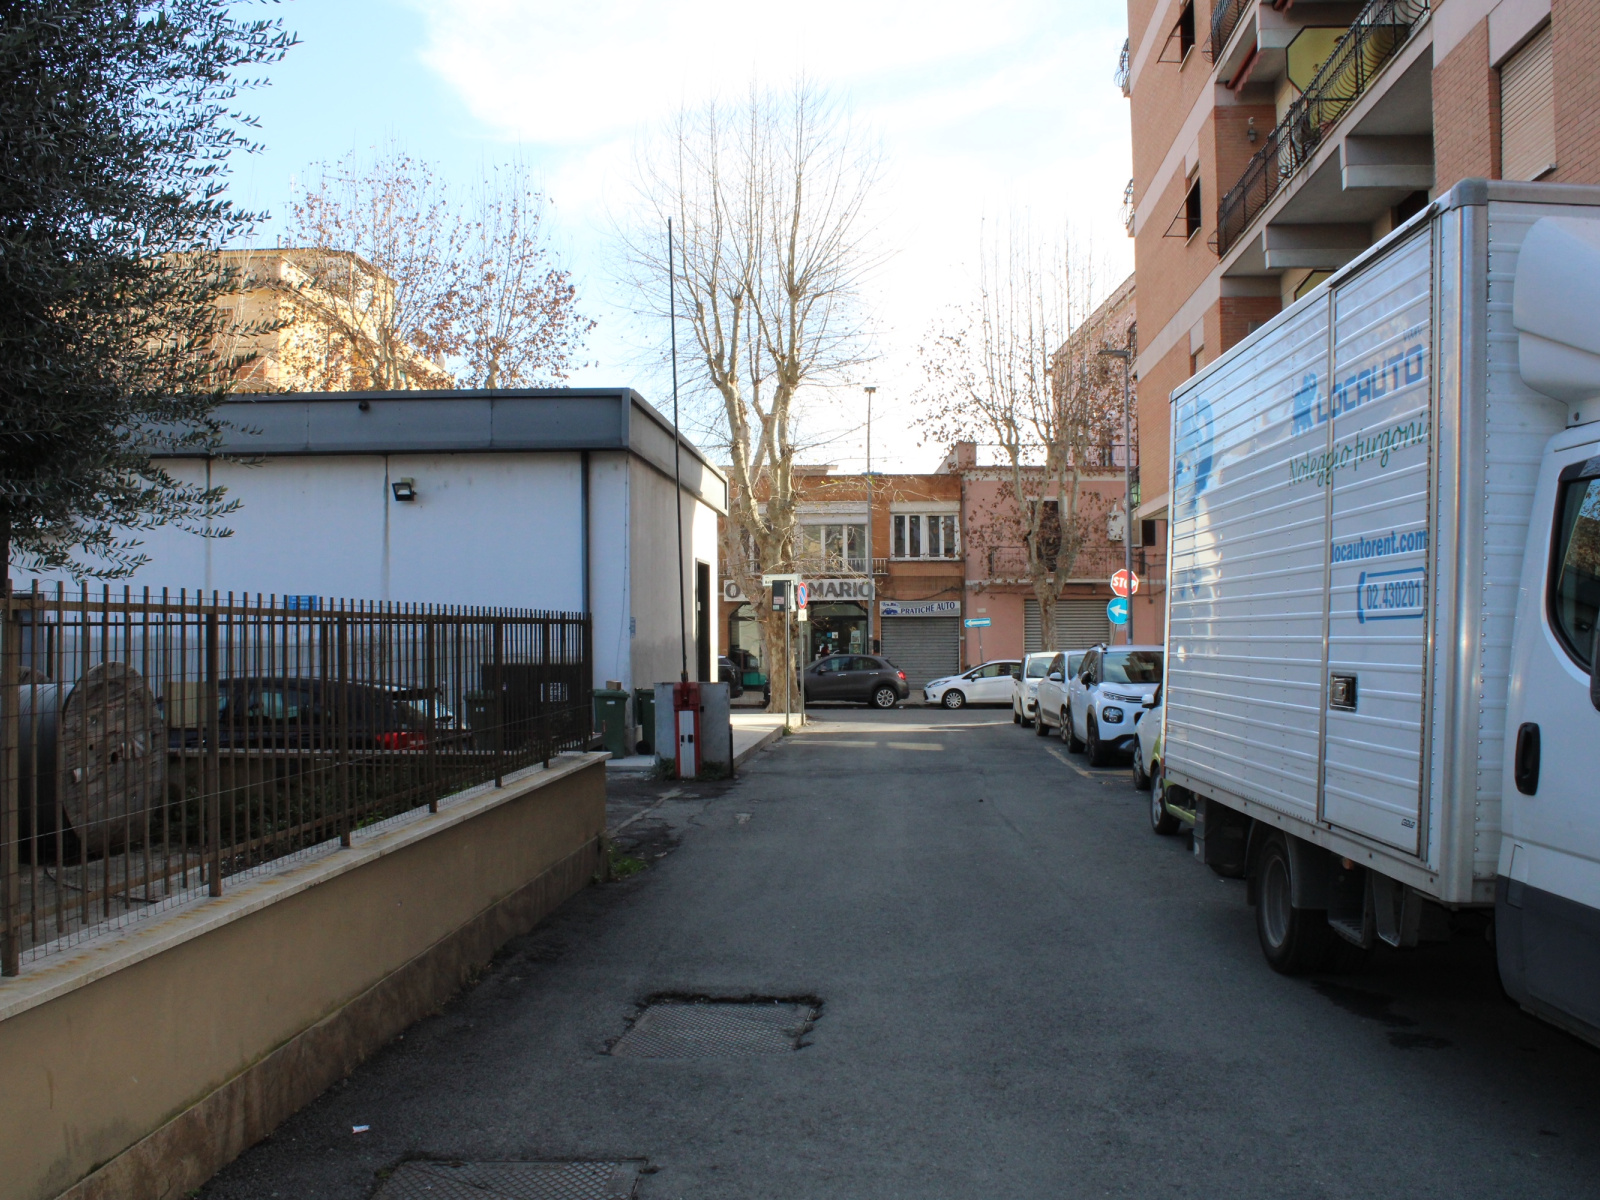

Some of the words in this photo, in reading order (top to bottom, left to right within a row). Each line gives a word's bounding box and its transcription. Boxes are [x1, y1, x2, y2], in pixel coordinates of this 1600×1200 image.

[1317, 344, 1423, 424] LOCAUTO
[1289, 444, 1353, 487] Noleggio
[1354, 411, 1429, 471] furgoni
[1331, 530, 1427, 563] locautorent.com
[808, 581, 873, 598] MARIO
[1366, 580, 1421, 610] 02.430201
[900, 604, 934, 614] PRATICHE
[936, 601, 956, 611] AUTO
